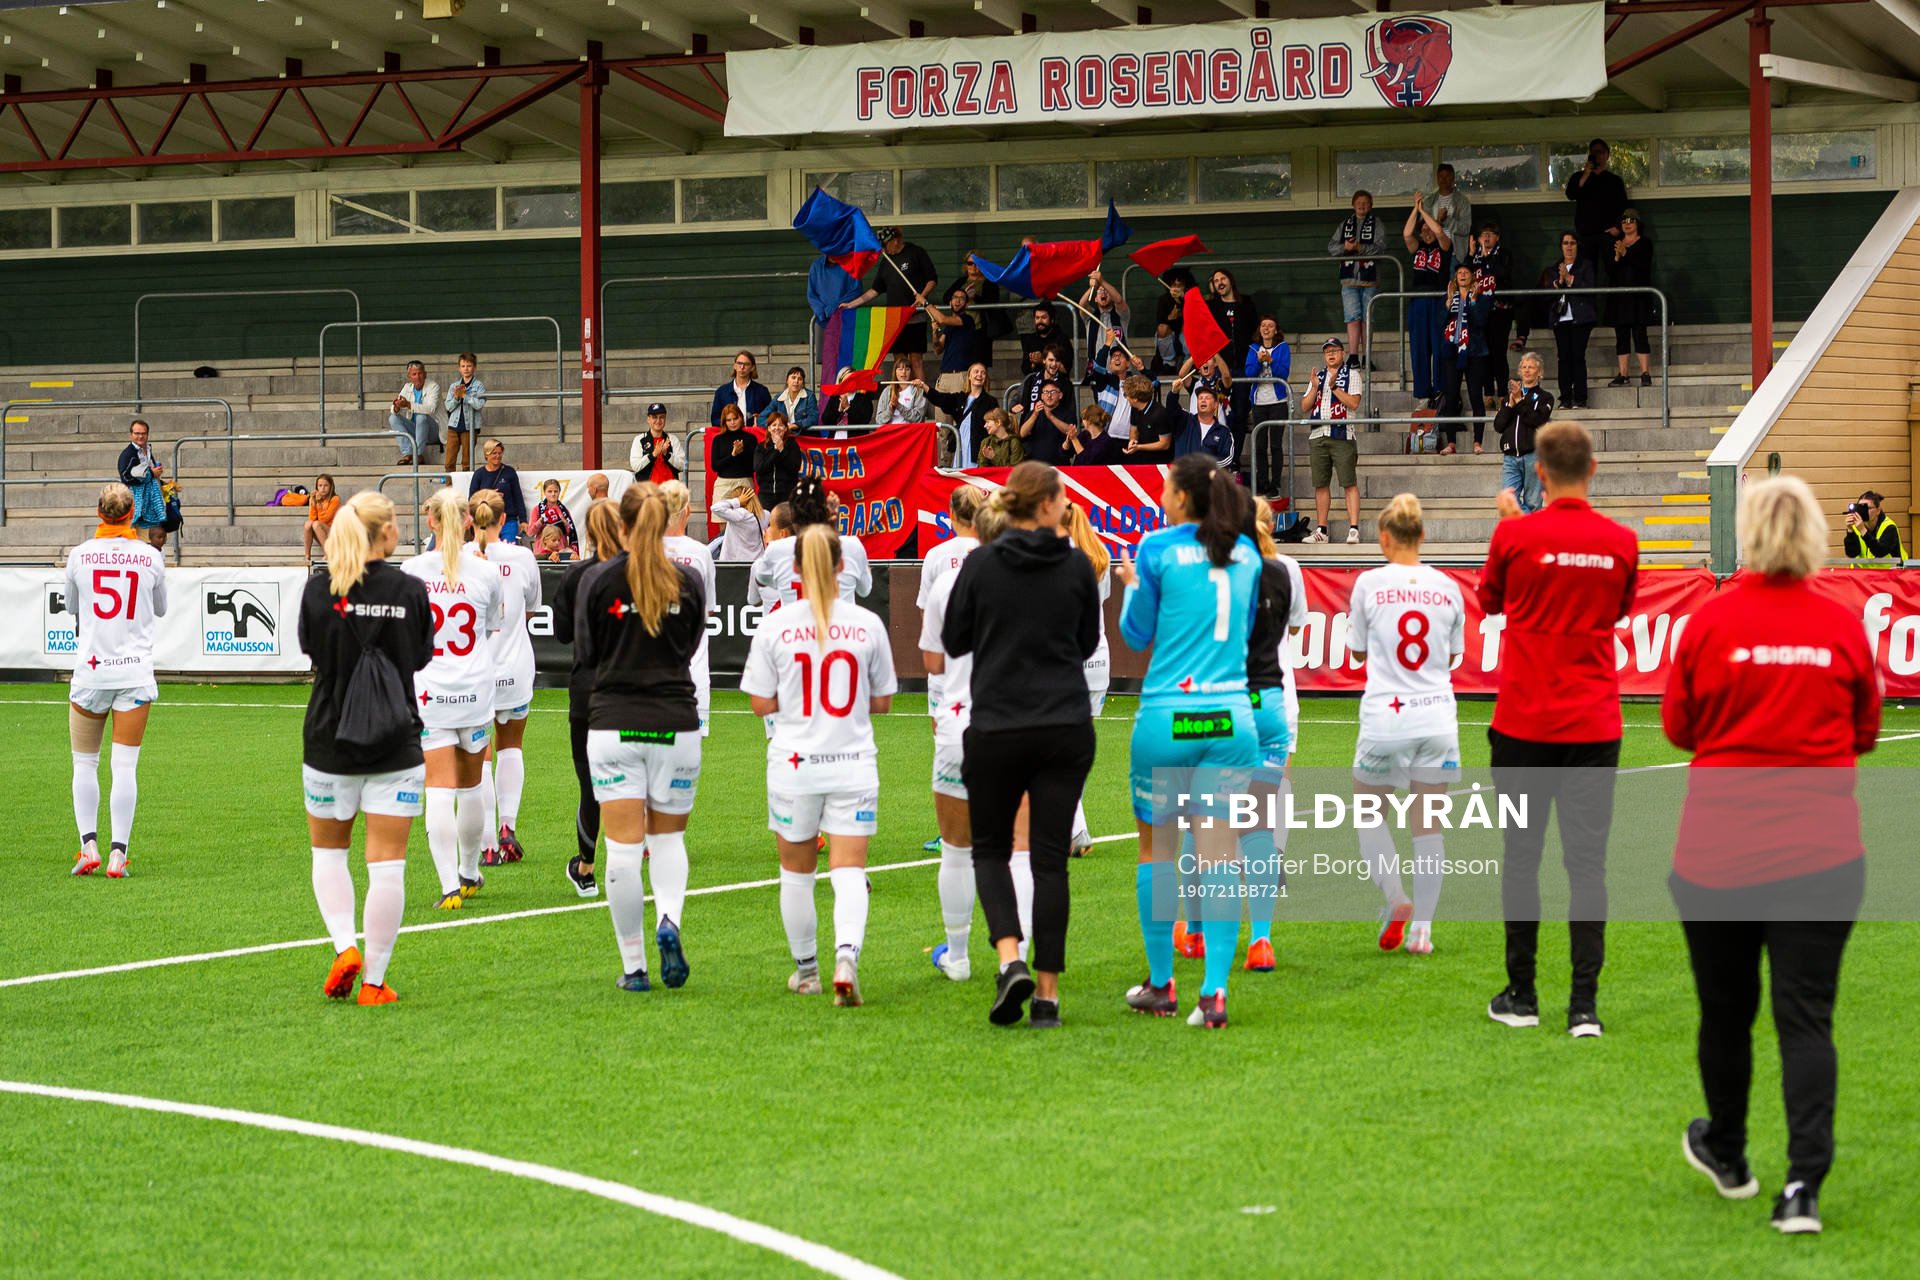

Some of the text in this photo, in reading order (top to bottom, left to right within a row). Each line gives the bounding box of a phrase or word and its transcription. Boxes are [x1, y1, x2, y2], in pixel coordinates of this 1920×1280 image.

[857, 27, 1353, 121] FORZA ROSENGÅRD
[798, 446, 865, 480] ORZA
[81, 553, 153, 568] TROELSGAARD
[93, 569, 139, 620] 51
[1208, 568, 1231, 642] 1
[1376, 589, 1452, 607] BENNISON
[47, 630, 75, 641] OTTO
[206, 631, 233, 641] OTTO
[206, 641, 274, 652] MAGNUSSON
[430, 602, 477, 657] 23
[781, 625, 867, 644] CANOVIC
[1397, 610, 1430, 672] 8
[794, 650, 859, 718] 10
